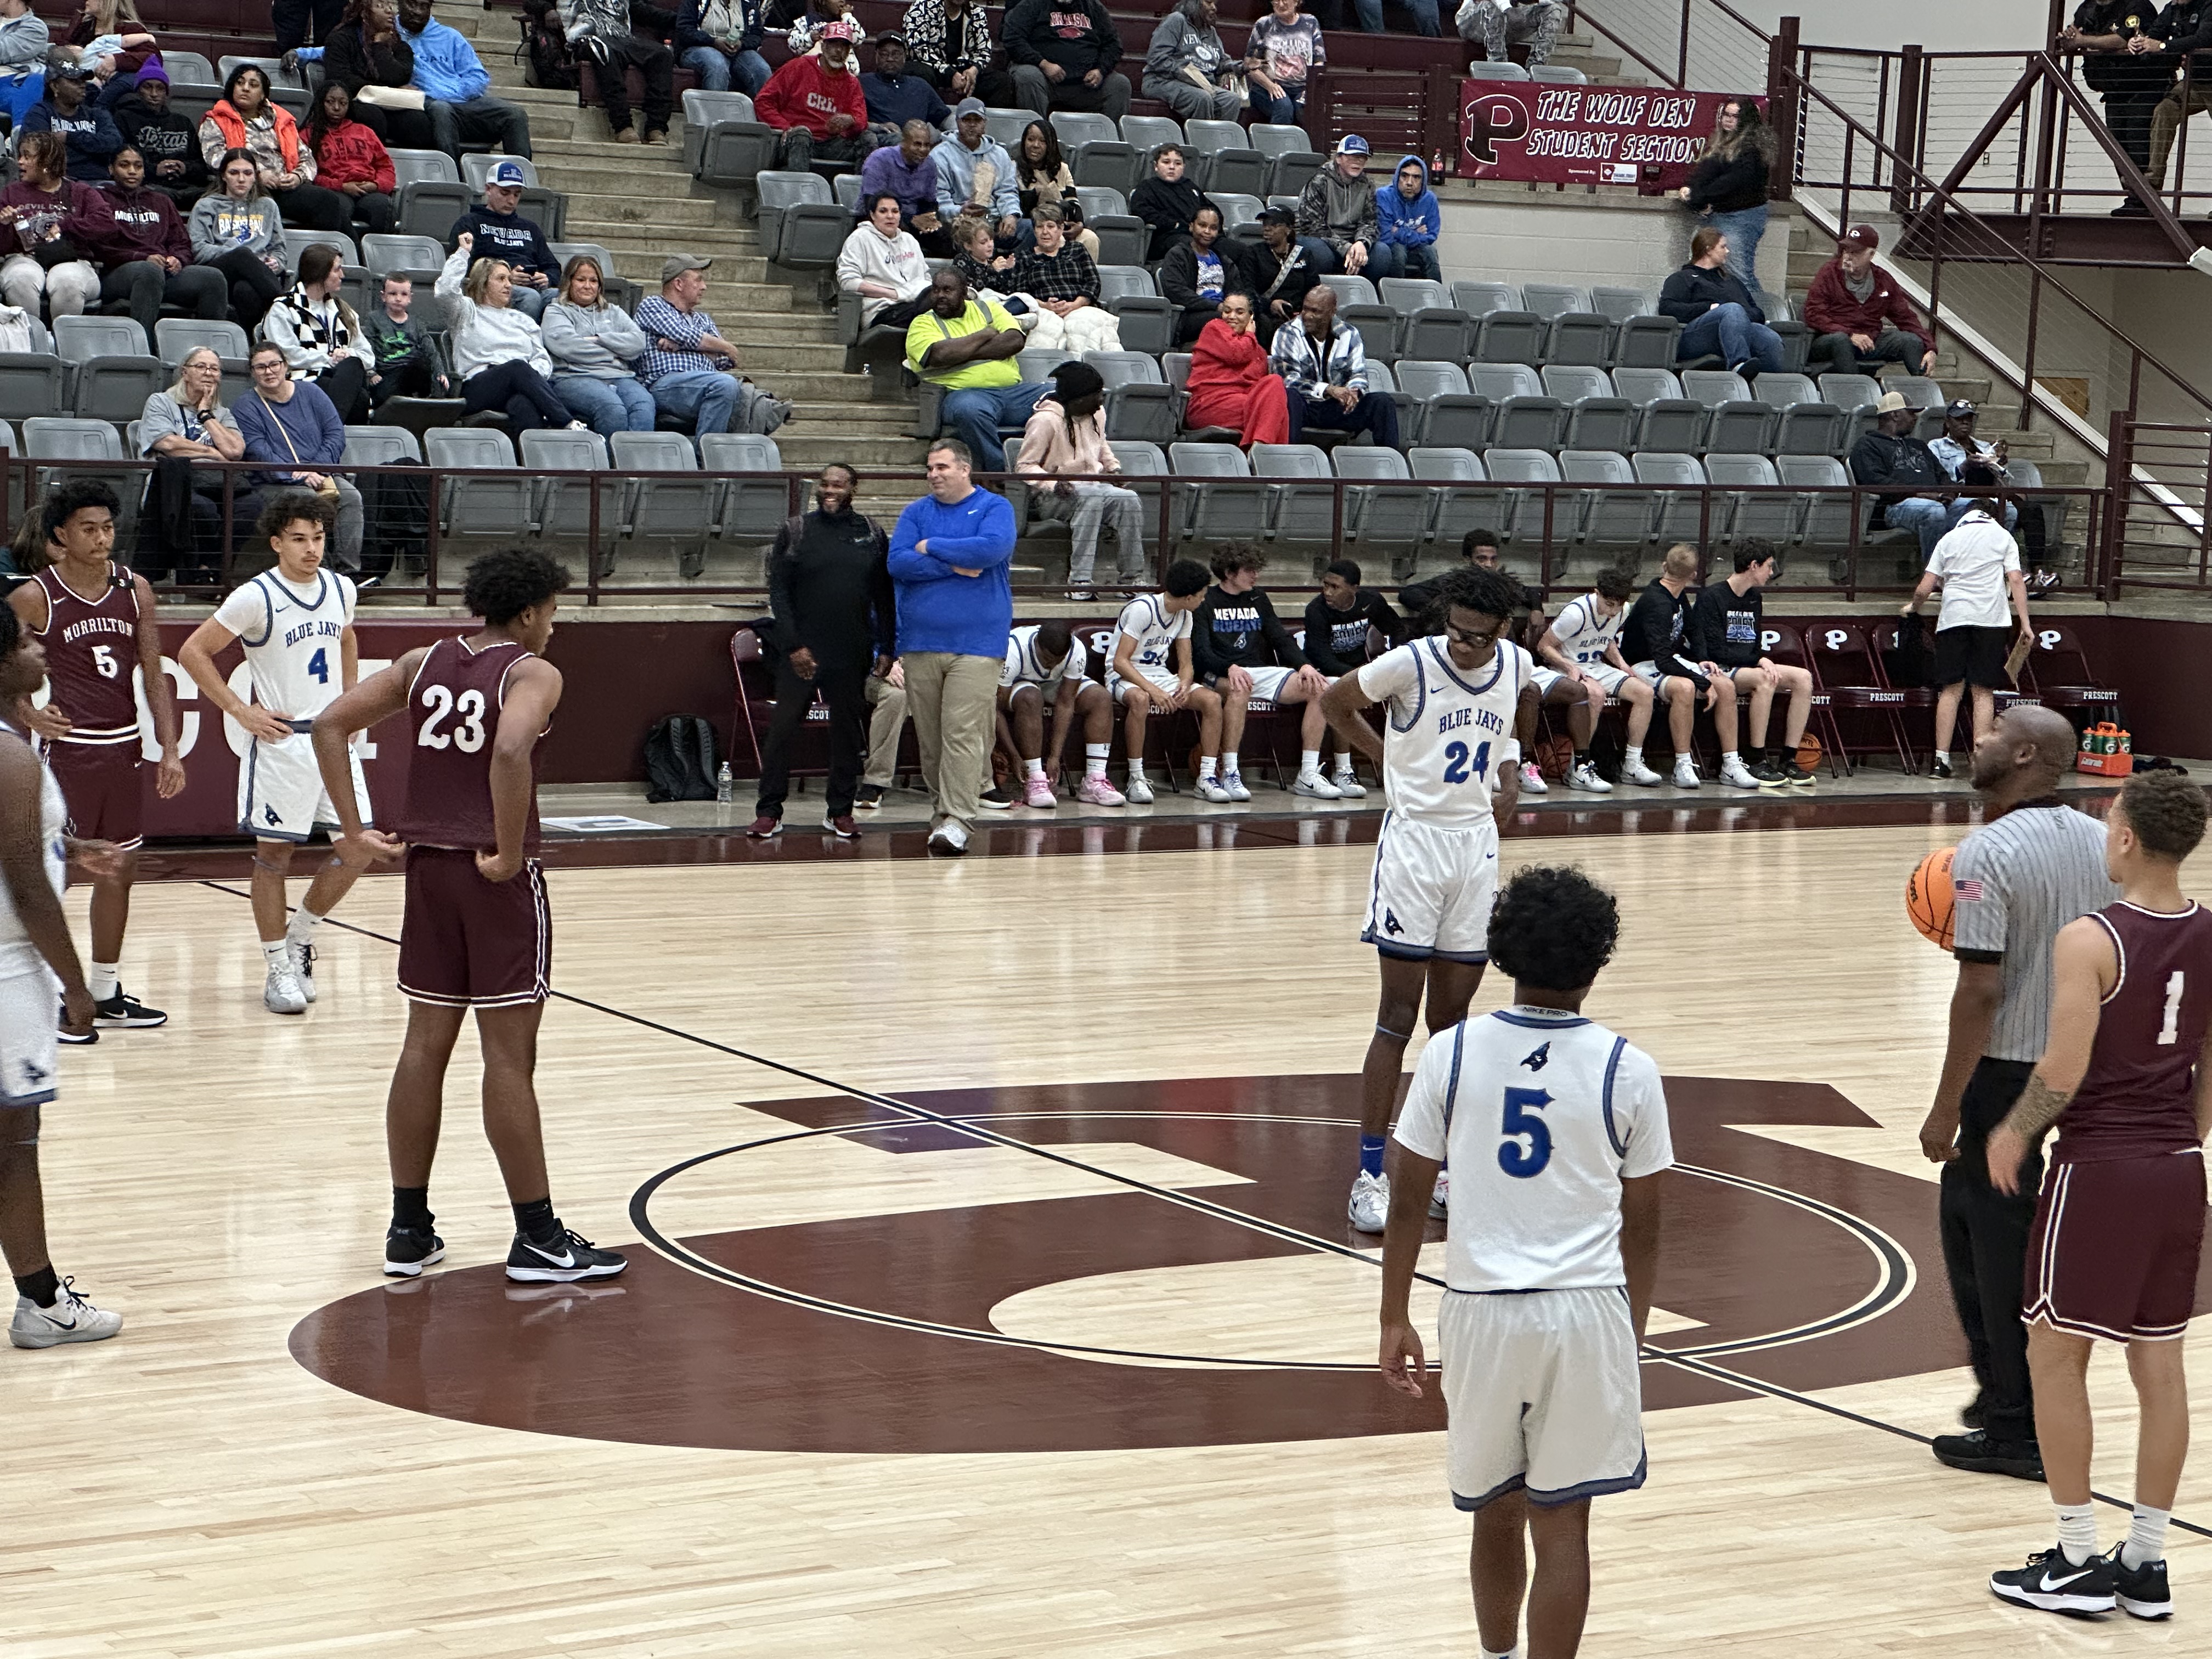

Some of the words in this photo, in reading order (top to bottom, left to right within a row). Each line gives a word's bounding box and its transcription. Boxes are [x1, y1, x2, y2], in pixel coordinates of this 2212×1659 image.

[1537, 91, 1581, 122] THE
[1584, 93, 1646, 126] WOLF
[1647, 97, 1696, 129] DEN
[1465, 94, 1530, 165] P
[1526, 129, 1618, 160] STUDENT
[1620, 133, 1706, 164] SECTION
[480, 224, 532, 241] NEVADA
[1214, 607, 1259, 620] NEVADA
[63, 617, 133, 643] MORRILTON
[285, 622, 313, 648] BLUE
[1762, 631, 1781, 651] P
[1825, 630, 1848, 650] P
[2039, 630, 2061, 650] P
[91, 645, 119, 678] 5
[308, 647, 328, 684] 4
[1870, 693, 1904, 702] PRESCOTT
[2083, 691, 2118, 699] PRESCOTT
[418, 684, 486, 753] 23
[1439, 708, 1471, 735] BLUE
[1476, 709, 1503, 735] JAYS
[1443, 741, 1491, 784] 24
[2157, 971, 2184, 1045] 1
[1498, 1086, 1556, 1179] 5
